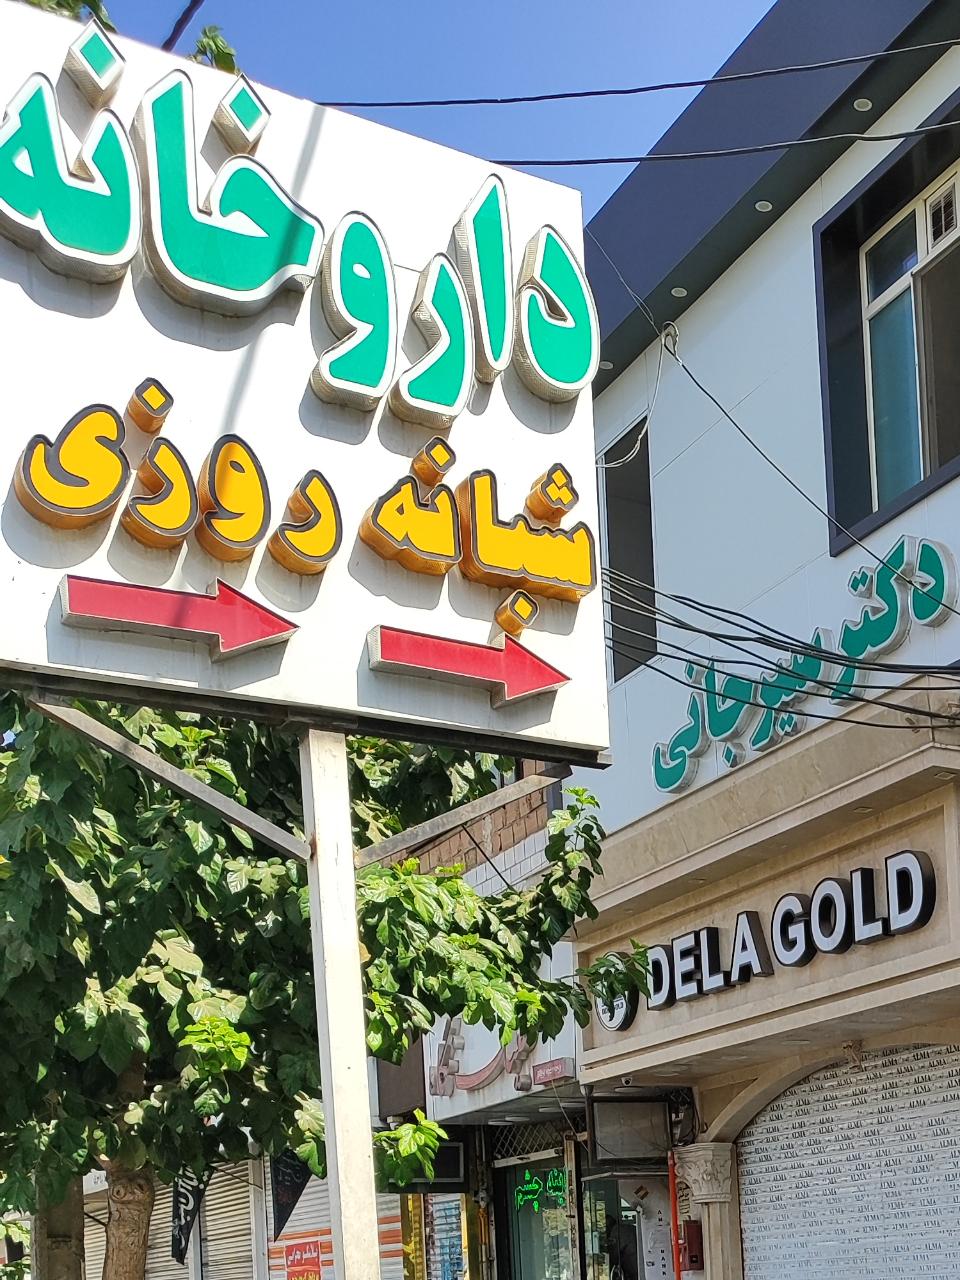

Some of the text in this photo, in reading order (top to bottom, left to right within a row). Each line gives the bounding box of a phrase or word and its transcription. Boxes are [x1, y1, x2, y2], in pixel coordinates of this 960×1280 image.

[0, 18, 600, 425] داروخانه
[15, 377, 595, 632] شبانه روزی
[829, 534, 959, 705] دکتر
[652, 627, 832, 792] سیرجانی
[647, 850, 936, 1010] DELA GOLD
